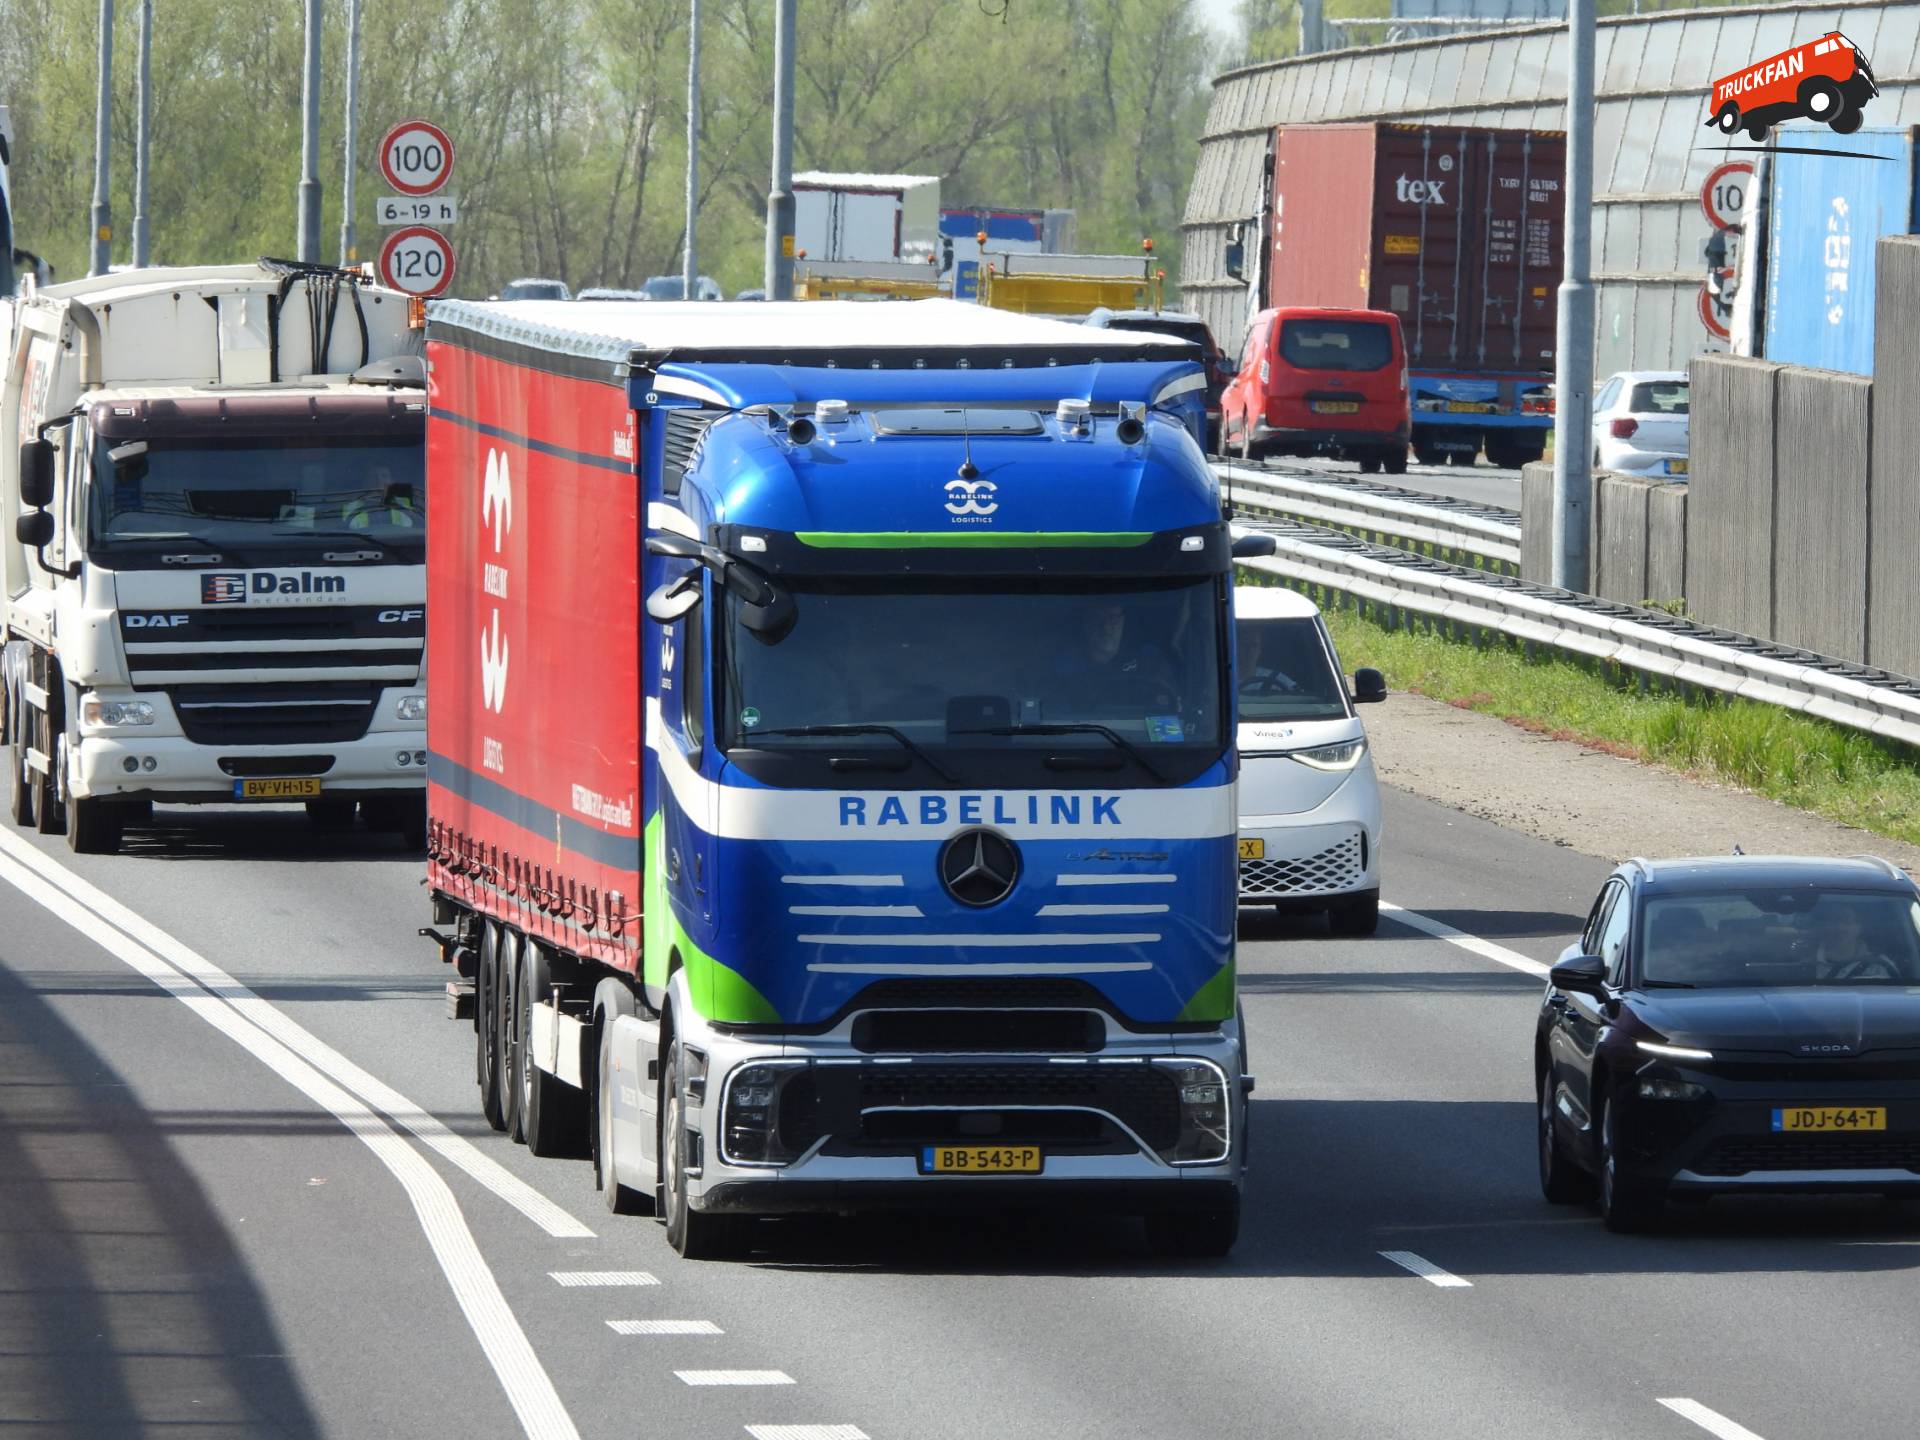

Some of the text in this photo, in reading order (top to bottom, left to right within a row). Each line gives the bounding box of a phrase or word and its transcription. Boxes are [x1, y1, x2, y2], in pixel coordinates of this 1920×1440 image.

[394, 145, 442, 172] 100
[1395, 171, 1447, 205] tex
[1714, 184, 1744, 212] 10
[385, 204, 452, 220] 6-19 h
[394, 250, 442, 278] 120
[947, 492, 994, 500] RABELINK
[951, 516, 993, 524] LOGISTICS
[252, 571, 346, 594] Dalm
[125, 610, 424, 628] DAF CF
[248, 780, 314, 795] BV-VH-15
[839, 795, 1123, 826] RABELINK
[1791, 1110, 1877, 1128] JDJ-64-T
[943, 1150, 1034, 1168] BB-543-P
